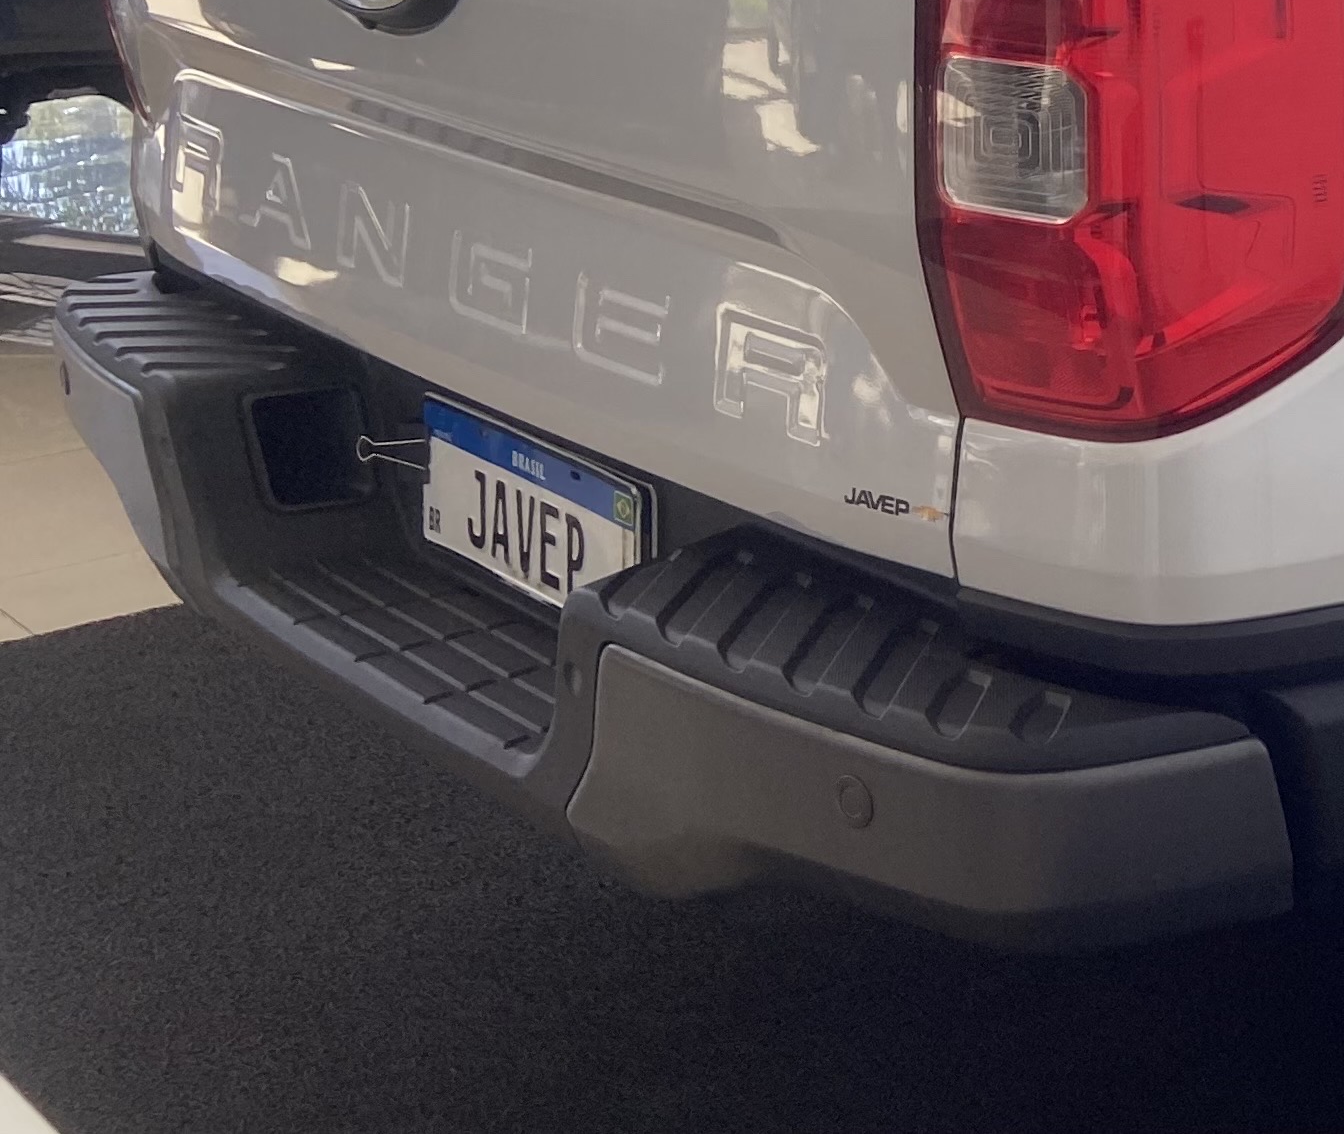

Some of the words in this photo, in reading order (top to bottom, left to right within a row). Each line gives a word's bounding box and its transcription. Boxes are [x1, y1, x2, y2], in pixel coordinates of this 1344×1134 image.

[169, 111, 830, 447] RANGER
[511, 450, 547, 481] BRASIL
[843, 487, 910, 516] JAVEP
[428, 505, 442, 534] BR
[467, 469, 586, 596] JAVEP
